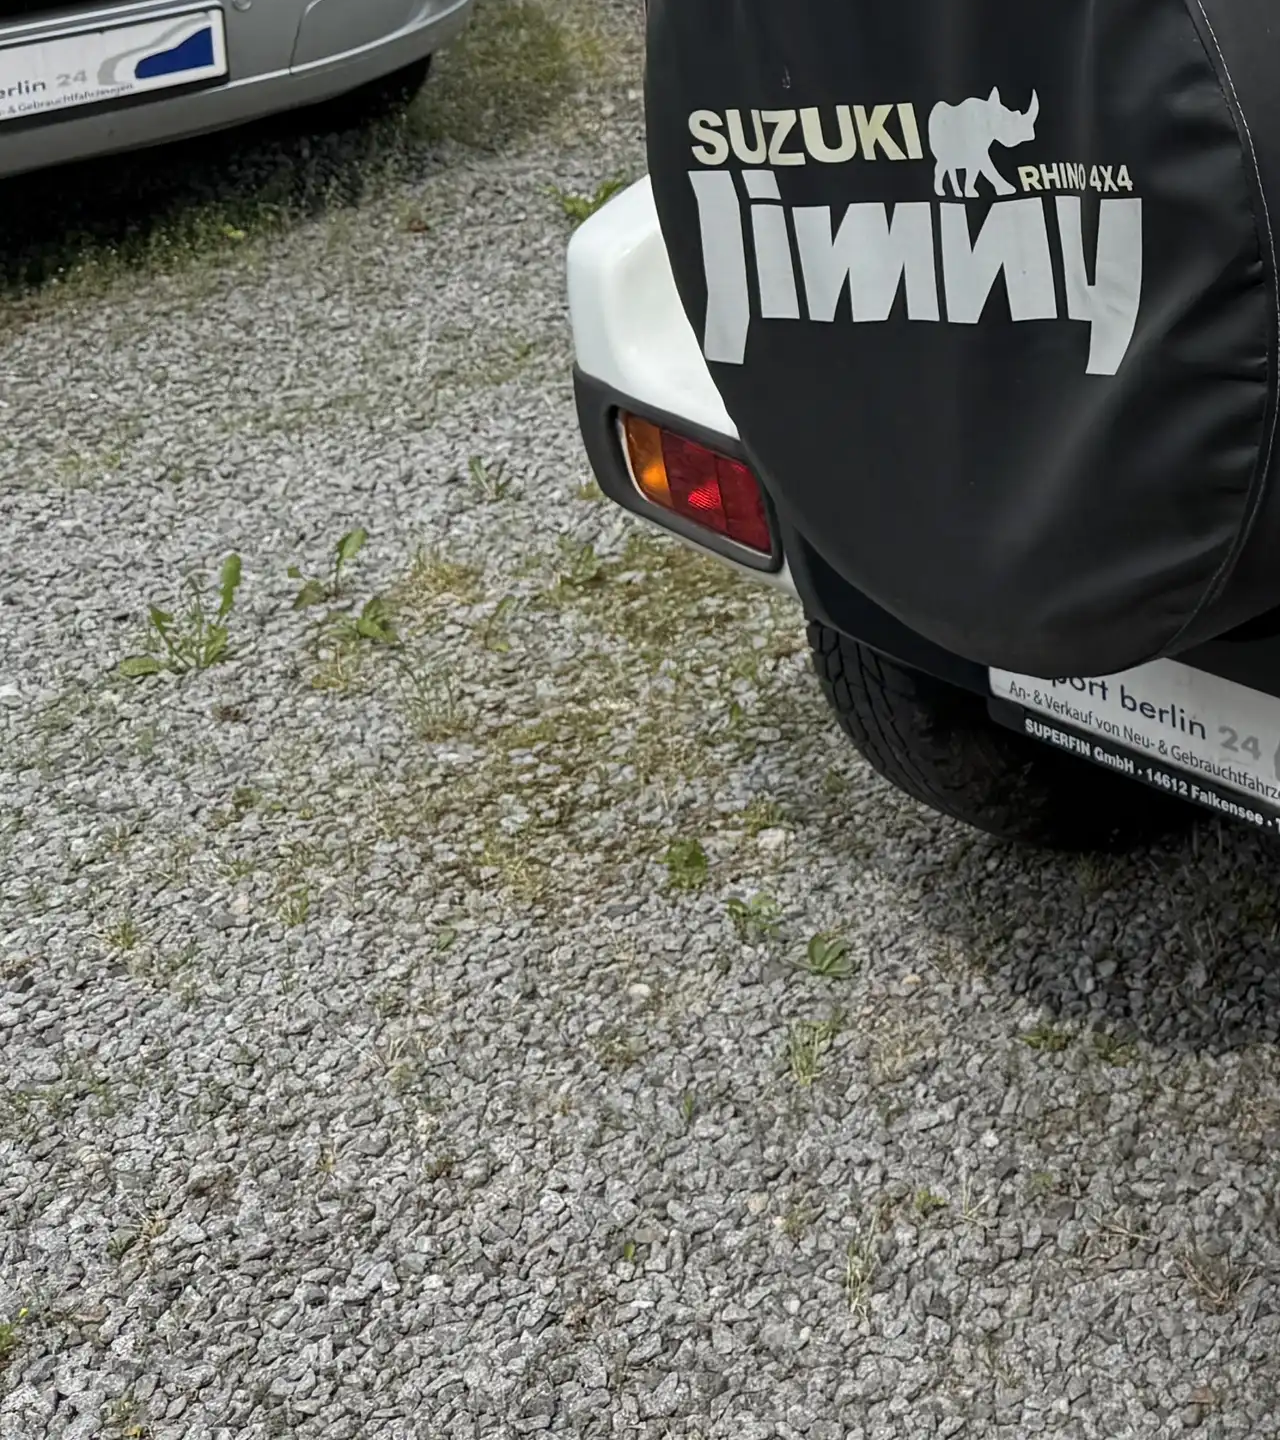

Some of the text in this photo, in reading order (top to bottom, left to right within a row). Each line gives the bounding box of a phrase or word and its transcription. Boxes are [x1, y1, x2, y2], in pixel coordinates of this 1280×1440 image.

[56, 69, 88, 88] 24
[687, 102, 924, 165] SUZUKI
[1018, 162, 1134, 192] RHINO 4X4
[1009, 680, 1031, 700] An-
[1033, 690, 1043, 706] &
[1044, 692, 1093, 726] Verkauf
[1095, 716, 1121, 738] von
[1123, 725, 1155, 749] Neu-
[1158, 739, 1169, 756] &
[1120, 684, 1206, 740] berlin
[1218, 725, 1262, 760] 24
[1025, 718, 1091, 757] SUPERFIN
[1093, 746, 1135, 775] GmbH
[1146, 768, 1189, 797] 14612
[1191, 784, 1264, 826] Falkensee
